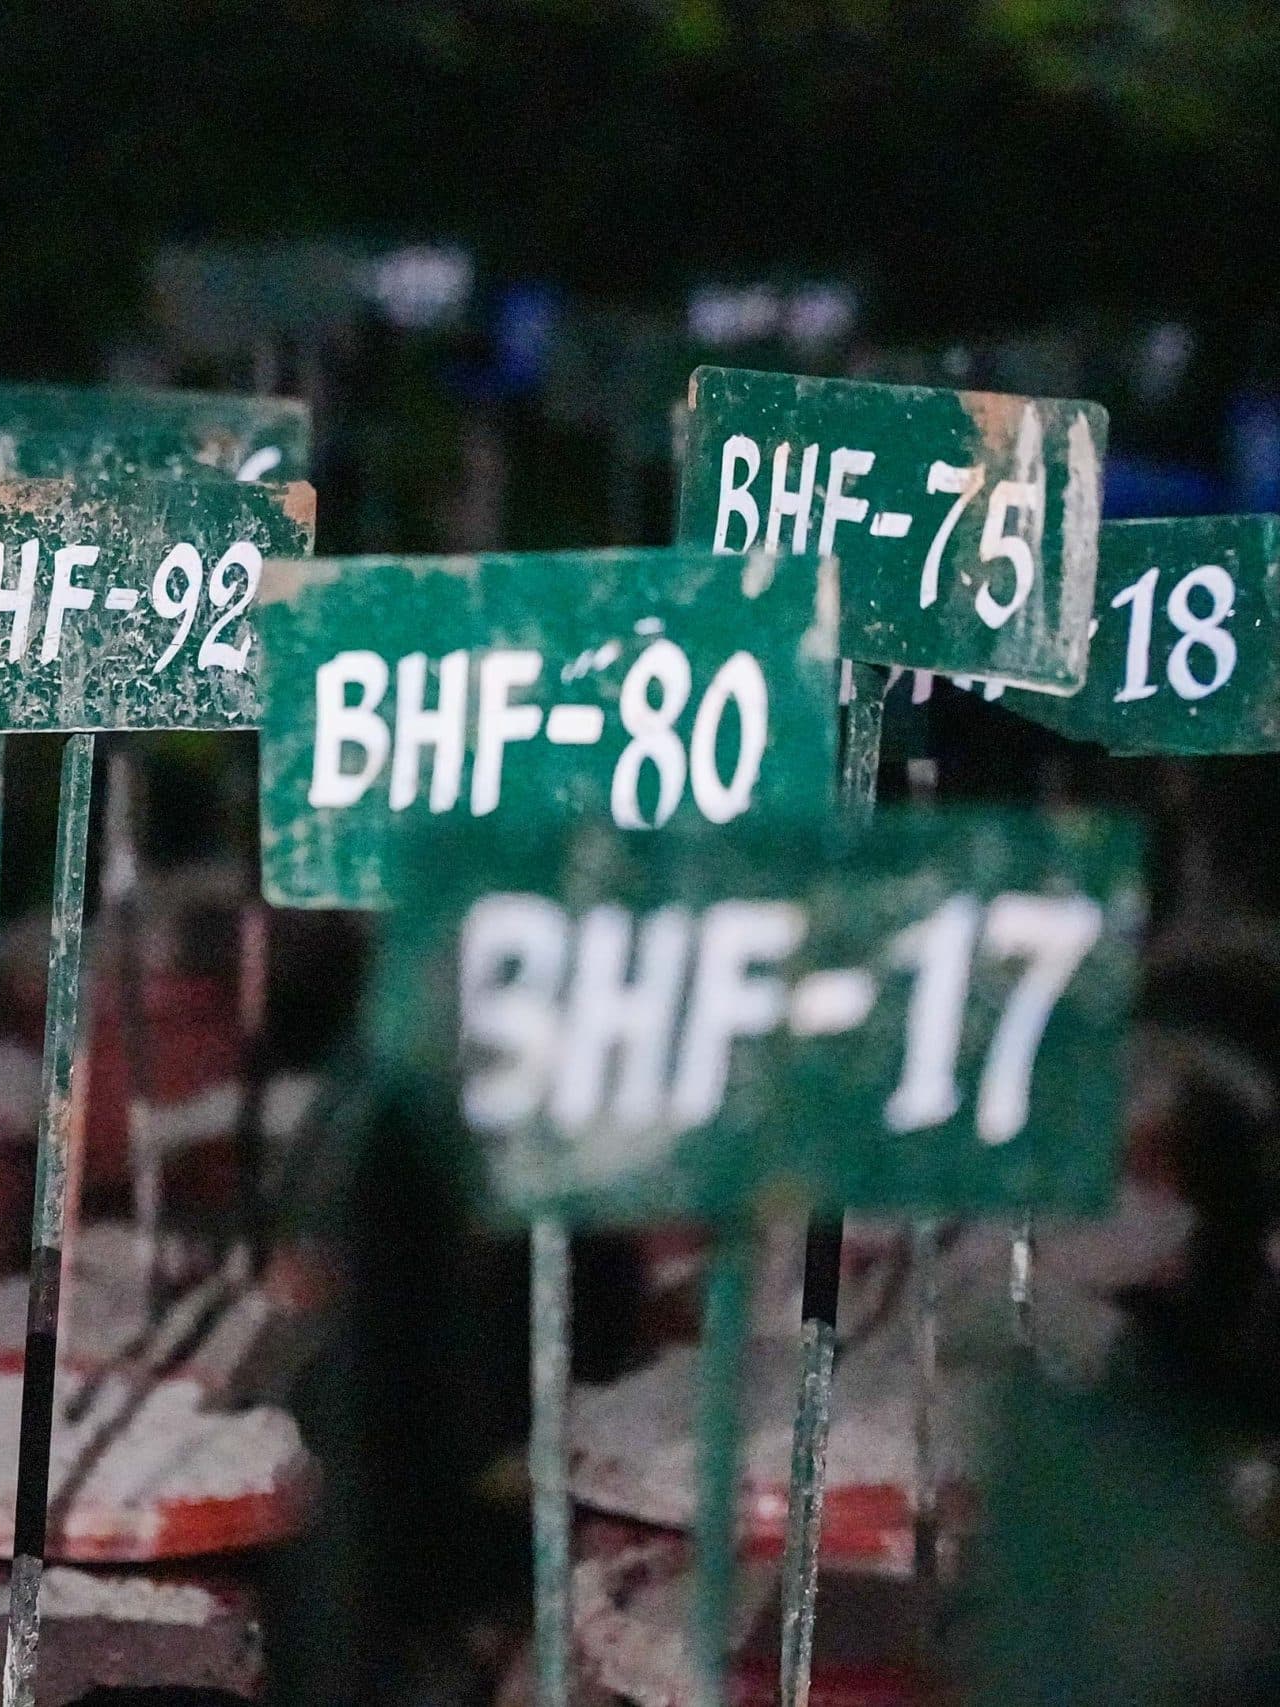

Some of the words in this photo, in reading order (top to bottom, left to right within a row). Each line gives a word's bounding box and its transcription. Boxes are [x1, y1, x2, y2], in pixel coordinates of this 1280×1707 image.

[712, 433, 1044, 630] BHF-75
[307, 638, 769, 830] BHF-80
[459, 890, 1104, 1146] BHF-17
